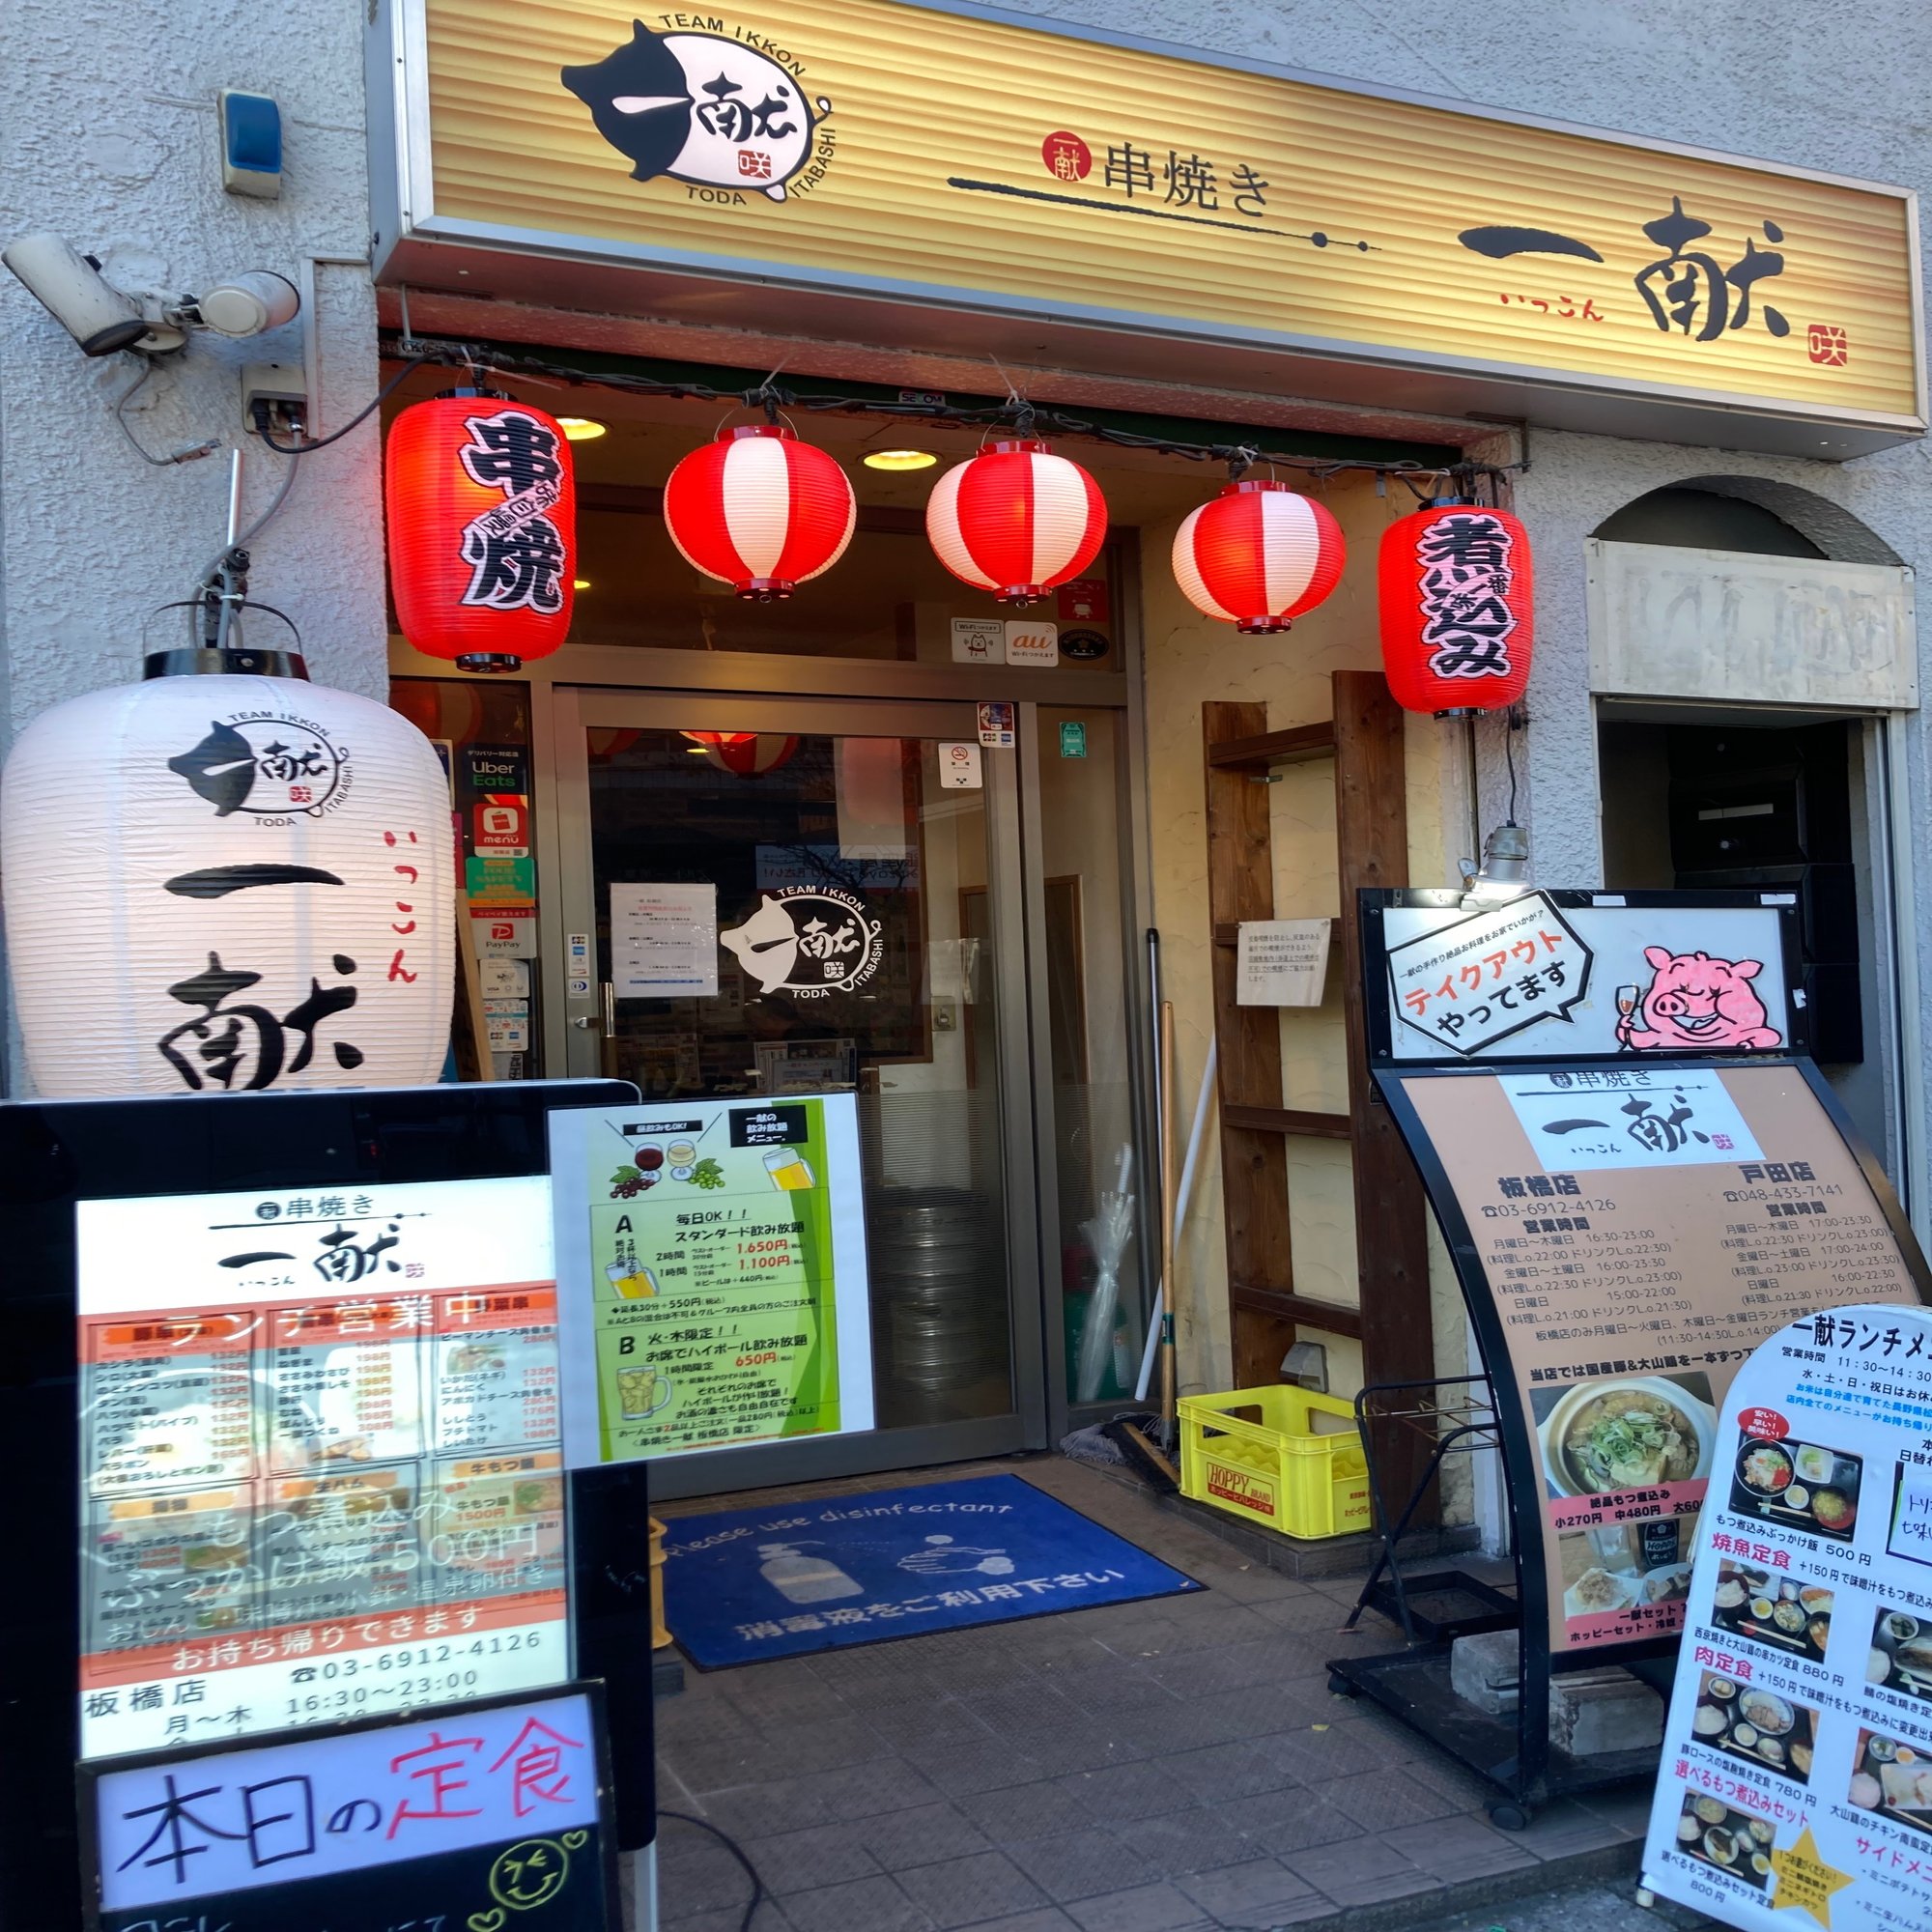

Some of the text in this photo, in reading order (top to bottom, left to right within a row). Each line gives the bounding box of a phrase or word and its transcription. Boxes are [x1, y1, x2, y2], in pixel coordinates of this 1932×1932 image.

[659, 13, 806, 76] TEAM IKKON
[788, 128, 837, 198] ITABASHI
[1104, 141, 1269, 218] 串焼き
[685, 185, 748, 206] TODA
[1458, 195, 1790, 342] 一献
[1499, 295, 1605, 322] いっこん
[1013, 634, 1052, 649] au
[229, 711, 331, 737] TEAM IKKON
[472, 761, 515, 774] Uber
[473, 774, 516, 786] Eats
[325, 765, 354, 813] ITABASHI
[254, 816, 297, 827] TODA
[777, 886, 865, 912] TEAM IKKON
[855, 939, 883, 985] ITABASHI
[1405, 929, 1562, 1016] テイクアウト
[158, 864, 364, 1091] 一献
[792, 988, 831, 999] TODA
[1436, 960, 1566, 1038] やってます
[747, 1122, 788, 1133] 飲み放題
[1542, 1094, 1711, 1152] 一献
[1571, 1144, 1622, 1153] いっこん
[1739, 1161, 1816, 1184] 戸田店
[1498, 1174, 1582, 1198] 板橋店
[287, 1195, 374, 1216] 串焼き
[1766, 1201, 1828, 1217] 営業時間
[615, 1215, 633, 1234] A
[676, 1221, 805, 1242] スタンダード飲み放題
[1523, 1216, 1590, 1234] 営業時間
[1808, 1215, 1872, 1229] 17:00-23:30
[1585, 1229, 1655, 1243] 16:30-23:00
[1821, 1242, 1884, 1256] 17:00-24:00
[217, 1224, 404, 1282] 一献
[656, 1251, 685, 1261] 2時間
[1597, 1257, 1666, 1272] 16:00-23:30
[660, 1266, 687, 1277] 1時間
[1747, 1269, 1895, 1291] 日曜日 16:00-22:30
[1515, 1286, 1676, 1310] 日曜日 15:00-22:00
[166, 1291, 487, 1348] ランチ営業中
[619, 1336, 636, 1354] B
[646, 1334, 808, 1362] お席でハイボール飲み放題
[1792, 1314, 1932, 1360] 一献ランチメ
[665, 1352, 777, 1375] 1時間限定 650円
[1782, 1346, 1826, 1363] 営業時間
[698, 1378, 777, 1395] それぞれのお席で
[1803, 1369, 1932, 1402] 水・土・日・祝日はお休
[1210, 1464, 1249, 1494] HOPPY
[758, 1517, 811, 1531] use
[819, 1502, 1014, 1523] disinfectant
[1555, 1513, 1603, 1528] 小270円
[1615, 1505, 1661, 1520] 中480円
[1716, 1514, 1818, 1552] もつ煮込みぶっかけ飯
[1712, 1531, 1792, 1570] 焼魚定食
[734, 1568, 1125, 1641] 消毒液をご利用下さい
[171, 1604, 483, 1672] お持ち帰りできます
[1694, 1646, 1753, 1681] 肉定食
[85, 1679, 208, 1719] 板橋店
[116, 1717, 585, 1885] 本日の定食
[1675, 1759, 1809, 1828] 選べるもつ煮込みセット
[1831, 1804, 1932, 1856] 大山鶏のチキン南蛮定
[1662, 1850, 1775, 1910] 選べるもつ煮込みセット定食
